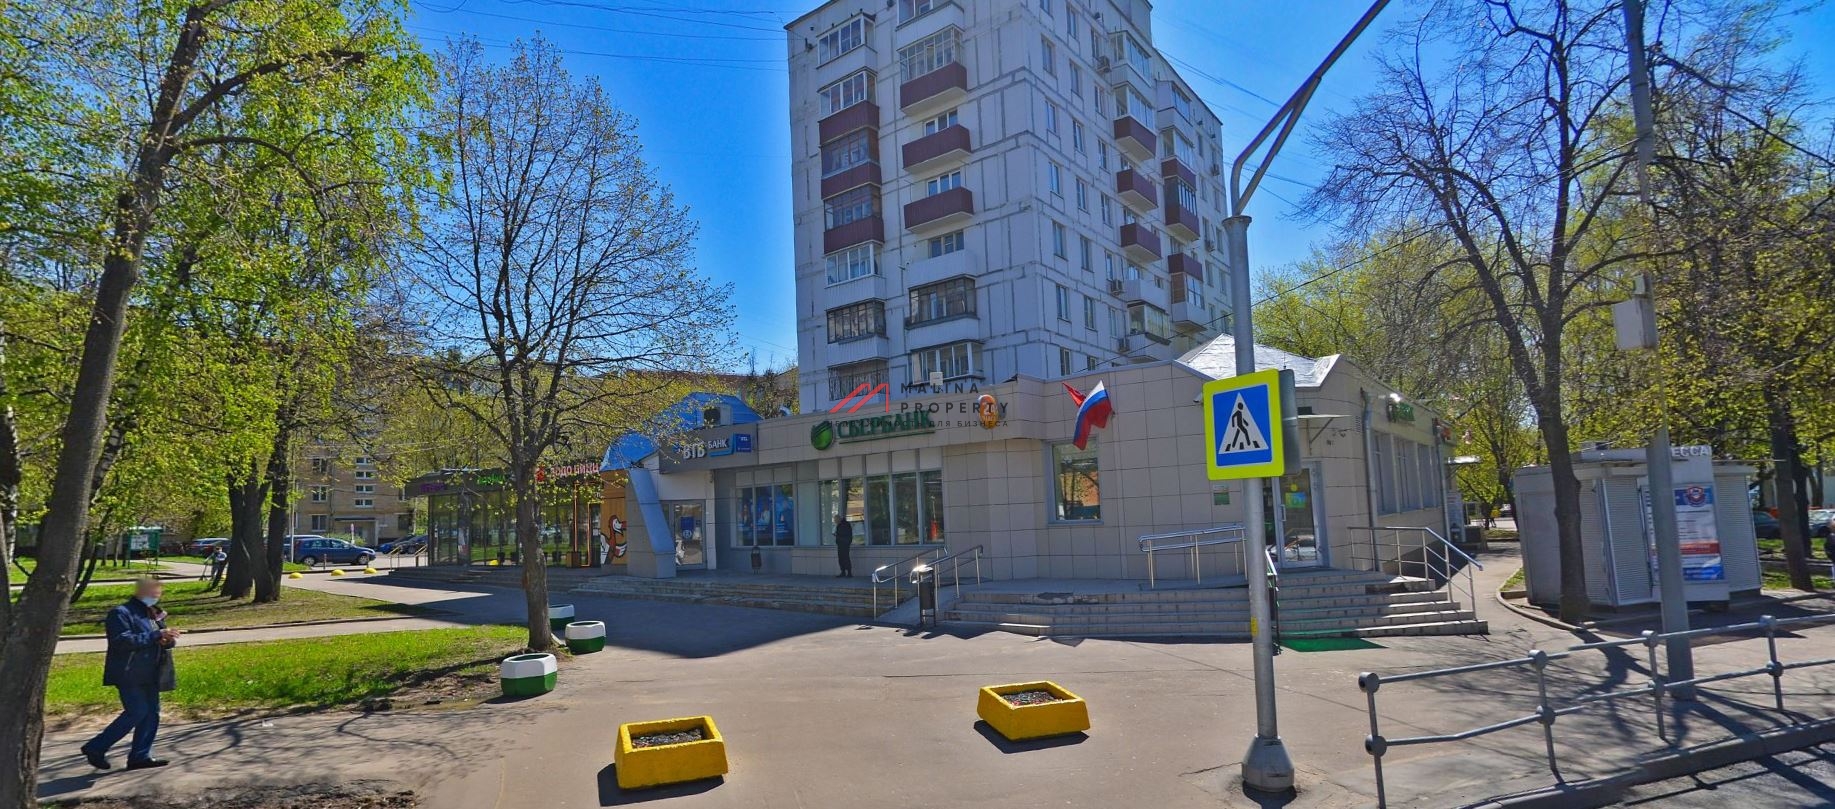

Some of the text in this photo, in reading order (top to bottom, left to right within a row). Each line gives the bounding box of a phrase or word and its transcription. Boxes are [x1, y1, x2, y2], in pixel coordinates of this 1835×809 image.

[837, 409, 931, 438] СБЕРБАНК
[683, 439, 727, 459] ВТБ БАНК
